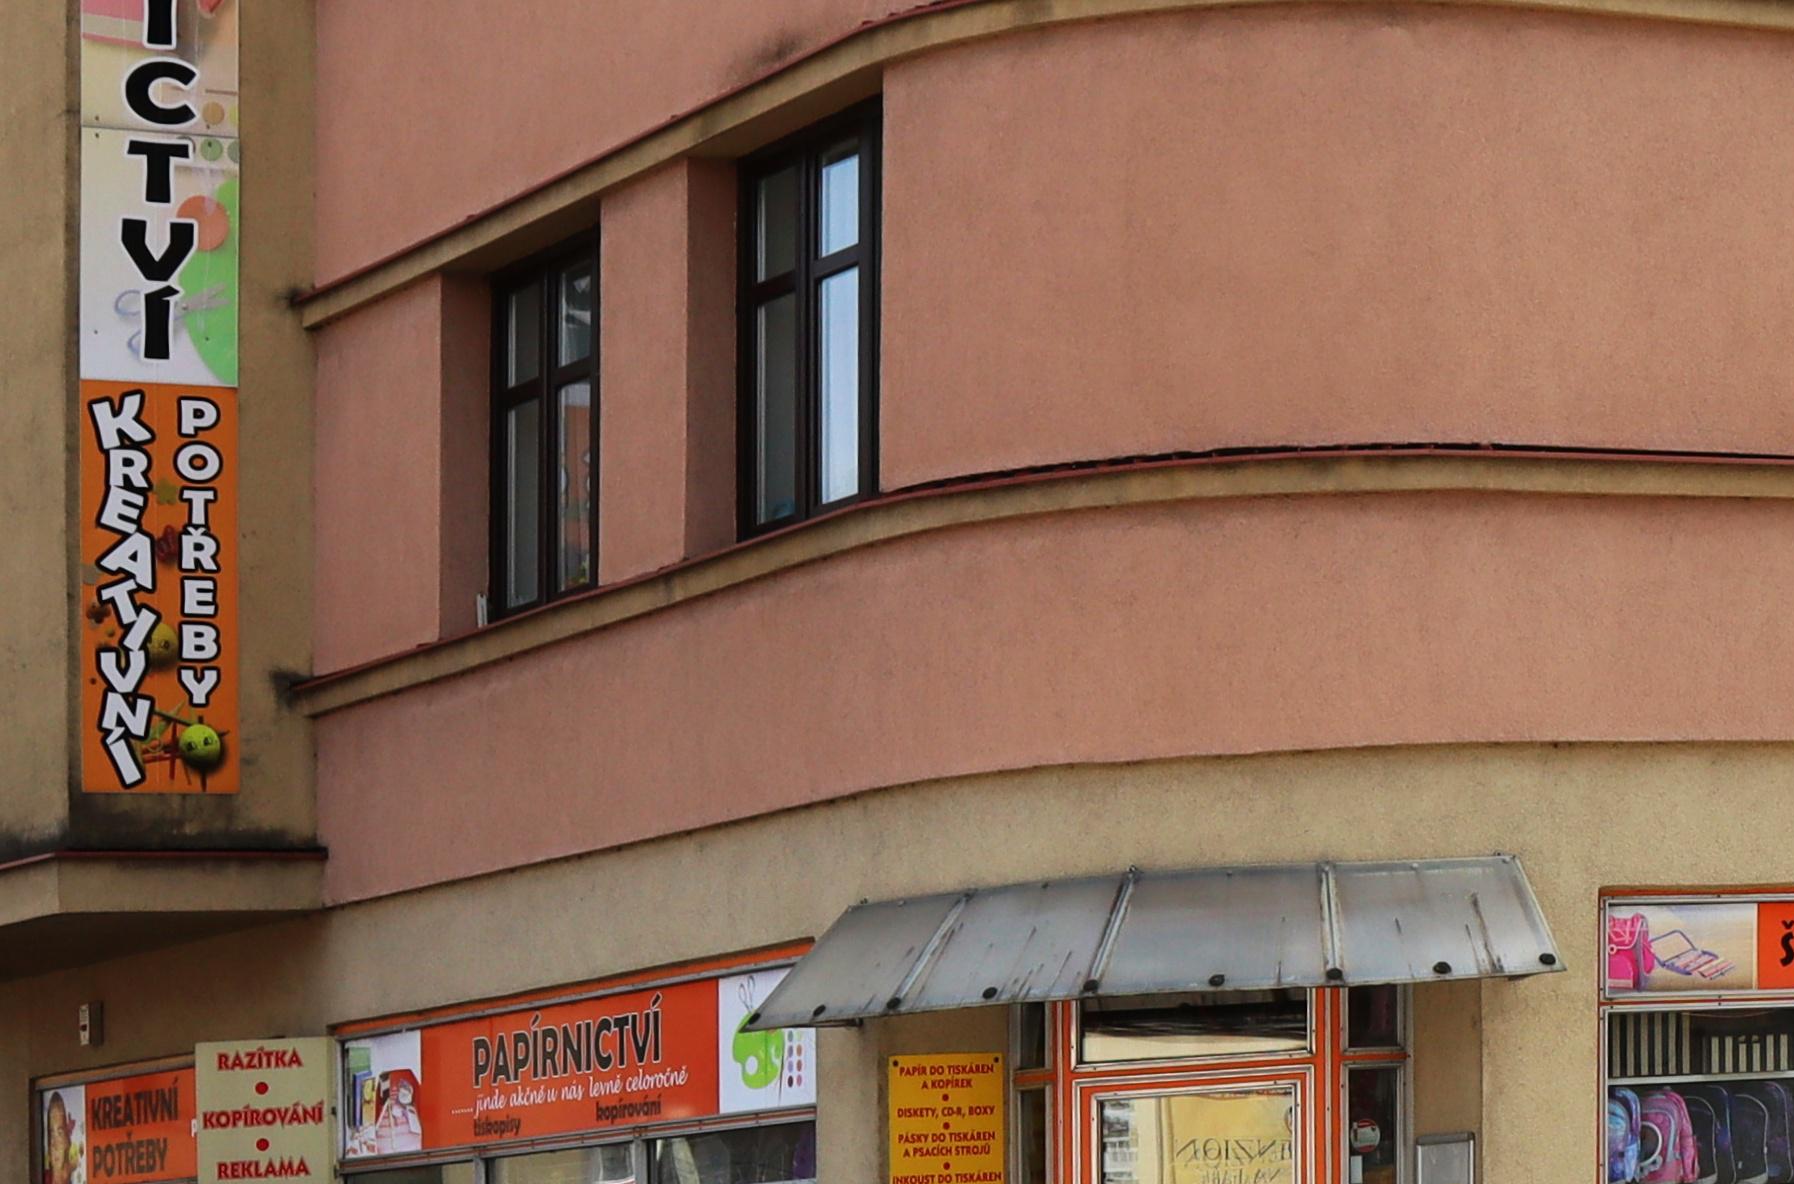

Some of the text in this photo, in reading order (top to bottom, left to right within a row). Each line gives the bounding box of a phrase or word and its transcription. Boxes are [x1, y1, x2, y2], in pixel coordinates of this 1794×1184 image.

[175, 397, 222, 706] POTŘEBY
[90, 391, 159, 787] KREATIVNÍ
[471, 993, 664, 1089] PAPÍRNICTVÍ
[217, 1046, 304, 1072] RAZÍTKA
[899, 1060, 995, 1077] PAPÍR DO TISKÁREN
[547, 1087, 558, 1103] u
[561, 1079, 586, 1102] nás
[625, 1065, 689, 1093] celoročně
[921, 1075, 973, 1090] A KOPÍREK
[91, 1075, 179, 1132] KREATIVNÍ
[203, 1098, 325, 1131] KOPÍROVÁNÍ
[595, 1092, 662, 1124] kopírování
[968, 1105, 996, 1116] BOXY
[898, 1128, 996, 1144] PÁSKY DO TISKÁREN
[903, 1147, 911, 1158] A
[912, 1143, 953, 1157] PSACÍCH
[93, 1131, 168, 1178] POTŘEBY
[217, 1154, 312, 1181] REKLAMA
[937, 1173, 953, 1184] DO
[955, 1169, 1002, 1184] TISKÁREN
